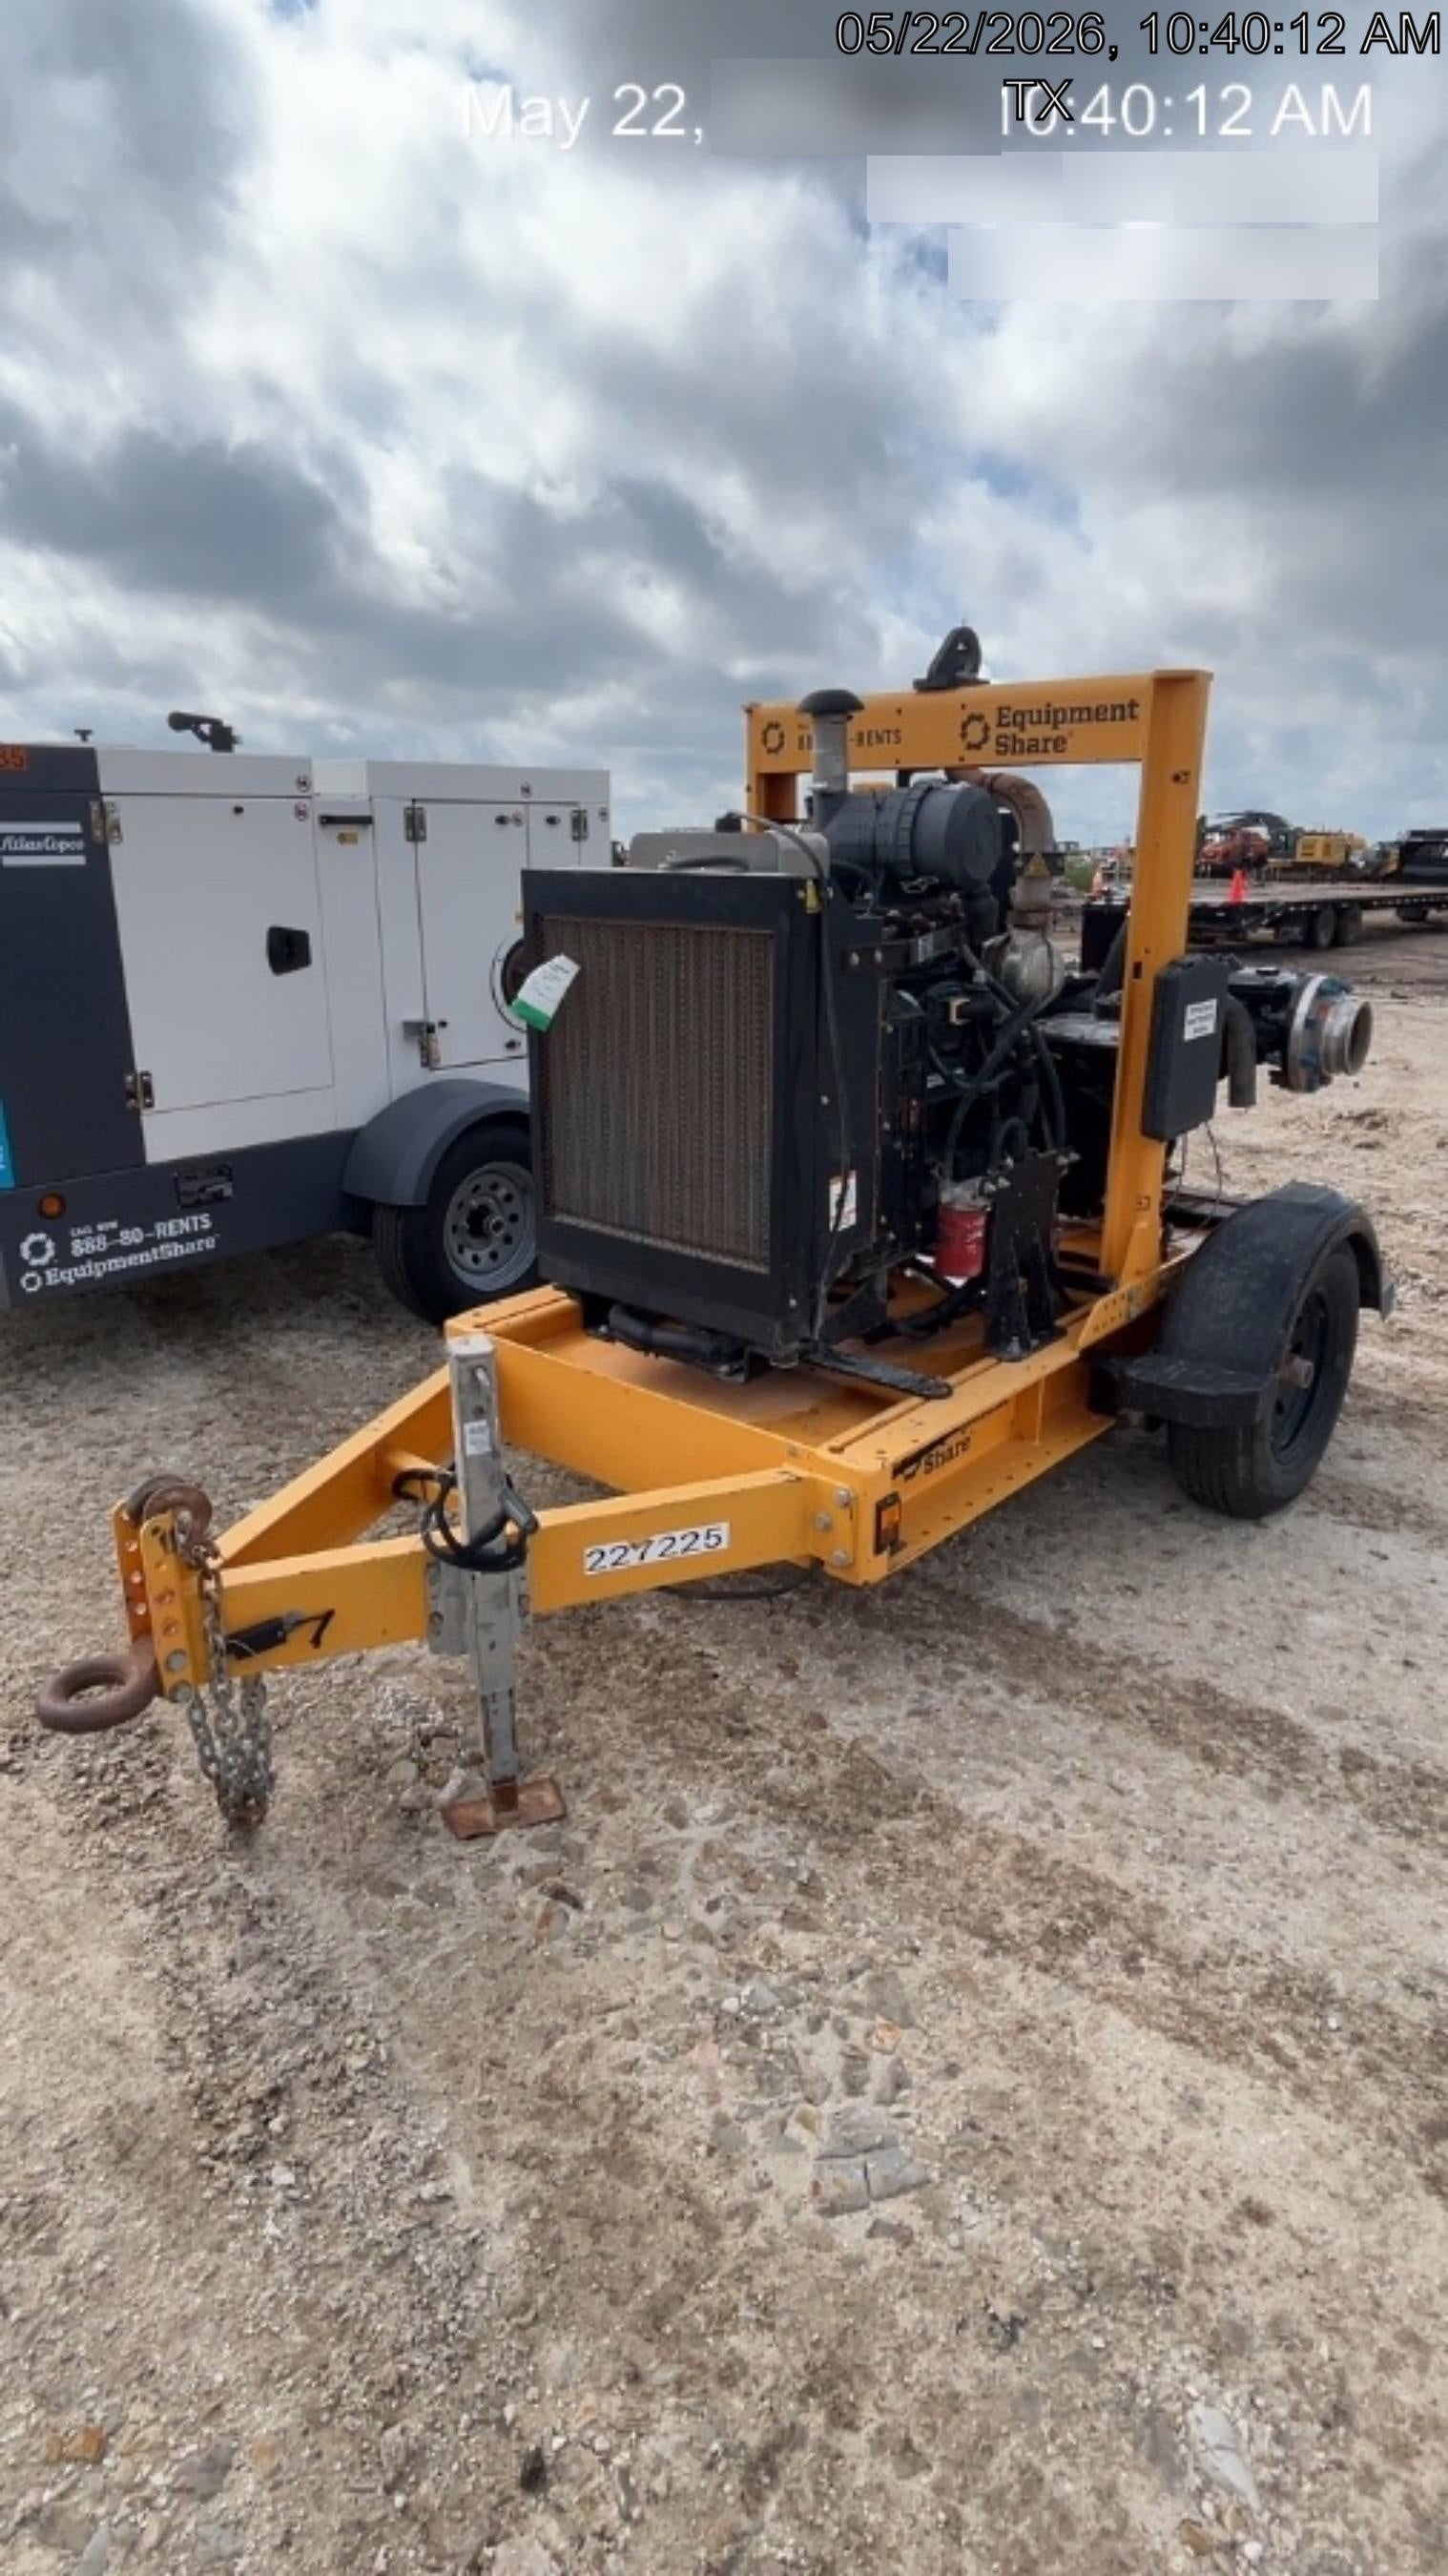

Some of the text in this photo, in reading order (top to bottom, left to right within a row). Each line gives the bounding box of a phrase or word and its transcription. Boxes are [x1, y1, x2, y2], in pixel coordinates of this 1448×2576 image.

[996, 697, 1140, 733] Equipment
[995, 734, 1067, 757] Share
[71, 1213, 212, 1257] 888-80-RENTS
[45, 1236, 216, 1285] EquipmentShare
[586, 1526, 724, 1572] 227225
